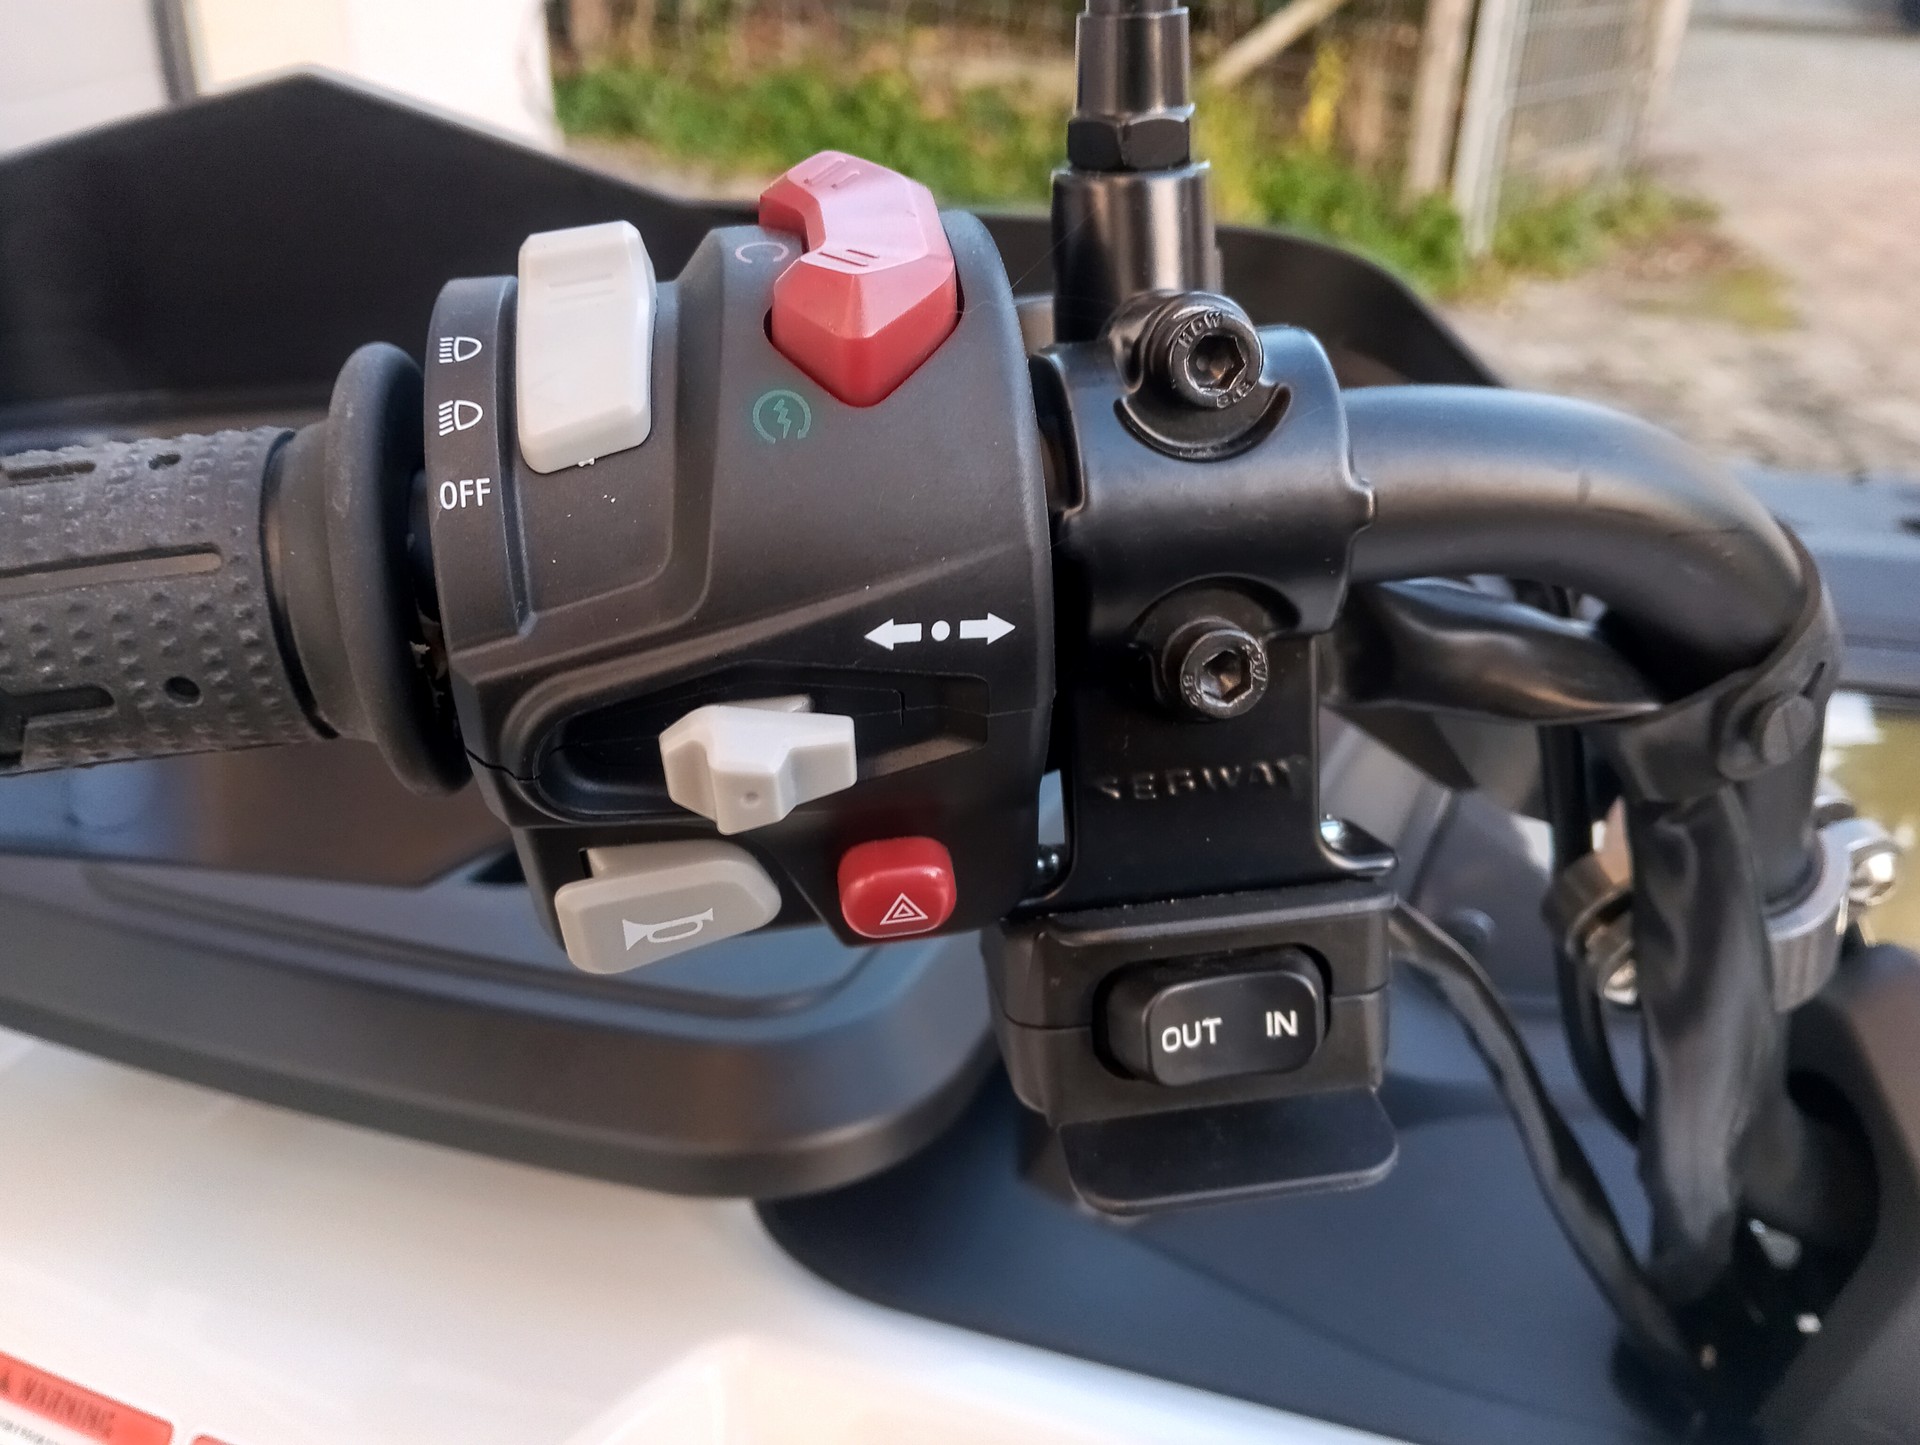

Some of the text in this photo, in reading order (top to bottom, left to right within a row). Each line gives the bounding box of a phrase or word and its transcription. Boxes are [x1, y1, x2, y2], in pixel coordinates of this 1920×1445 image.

[439, 477, 491, 510] OFF
[1161, 1009, 1299, 1054] OUT IN
